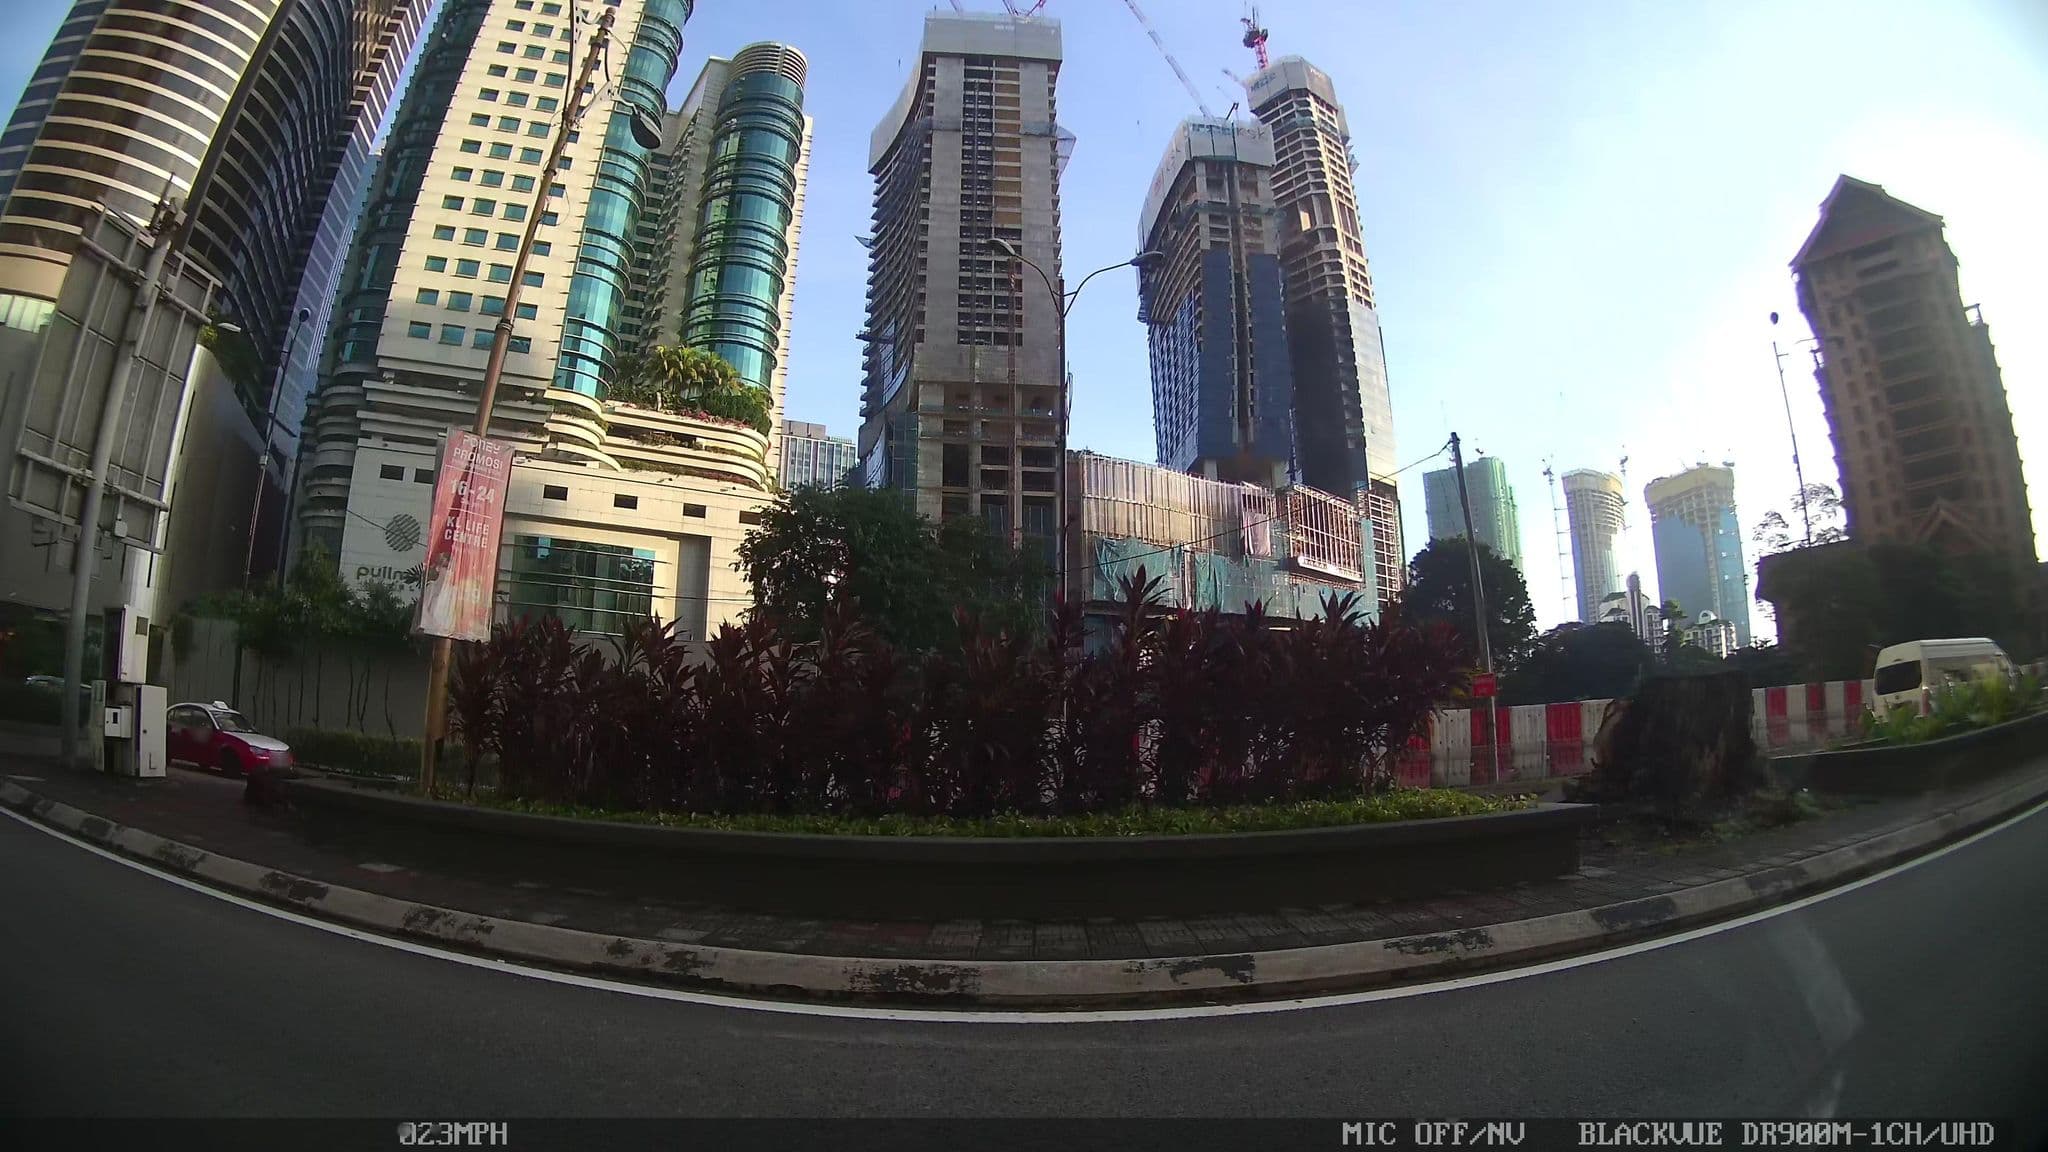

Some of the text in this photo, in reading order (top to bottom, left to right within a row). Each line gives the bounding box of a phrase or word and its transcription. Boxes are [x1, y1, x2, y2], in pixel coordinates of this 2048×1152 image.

[453, 447, 503, 471] PROMOSI
[446, 516, 490, 536] KL LIFE
[444, 528, 488, 549] CENTRE
